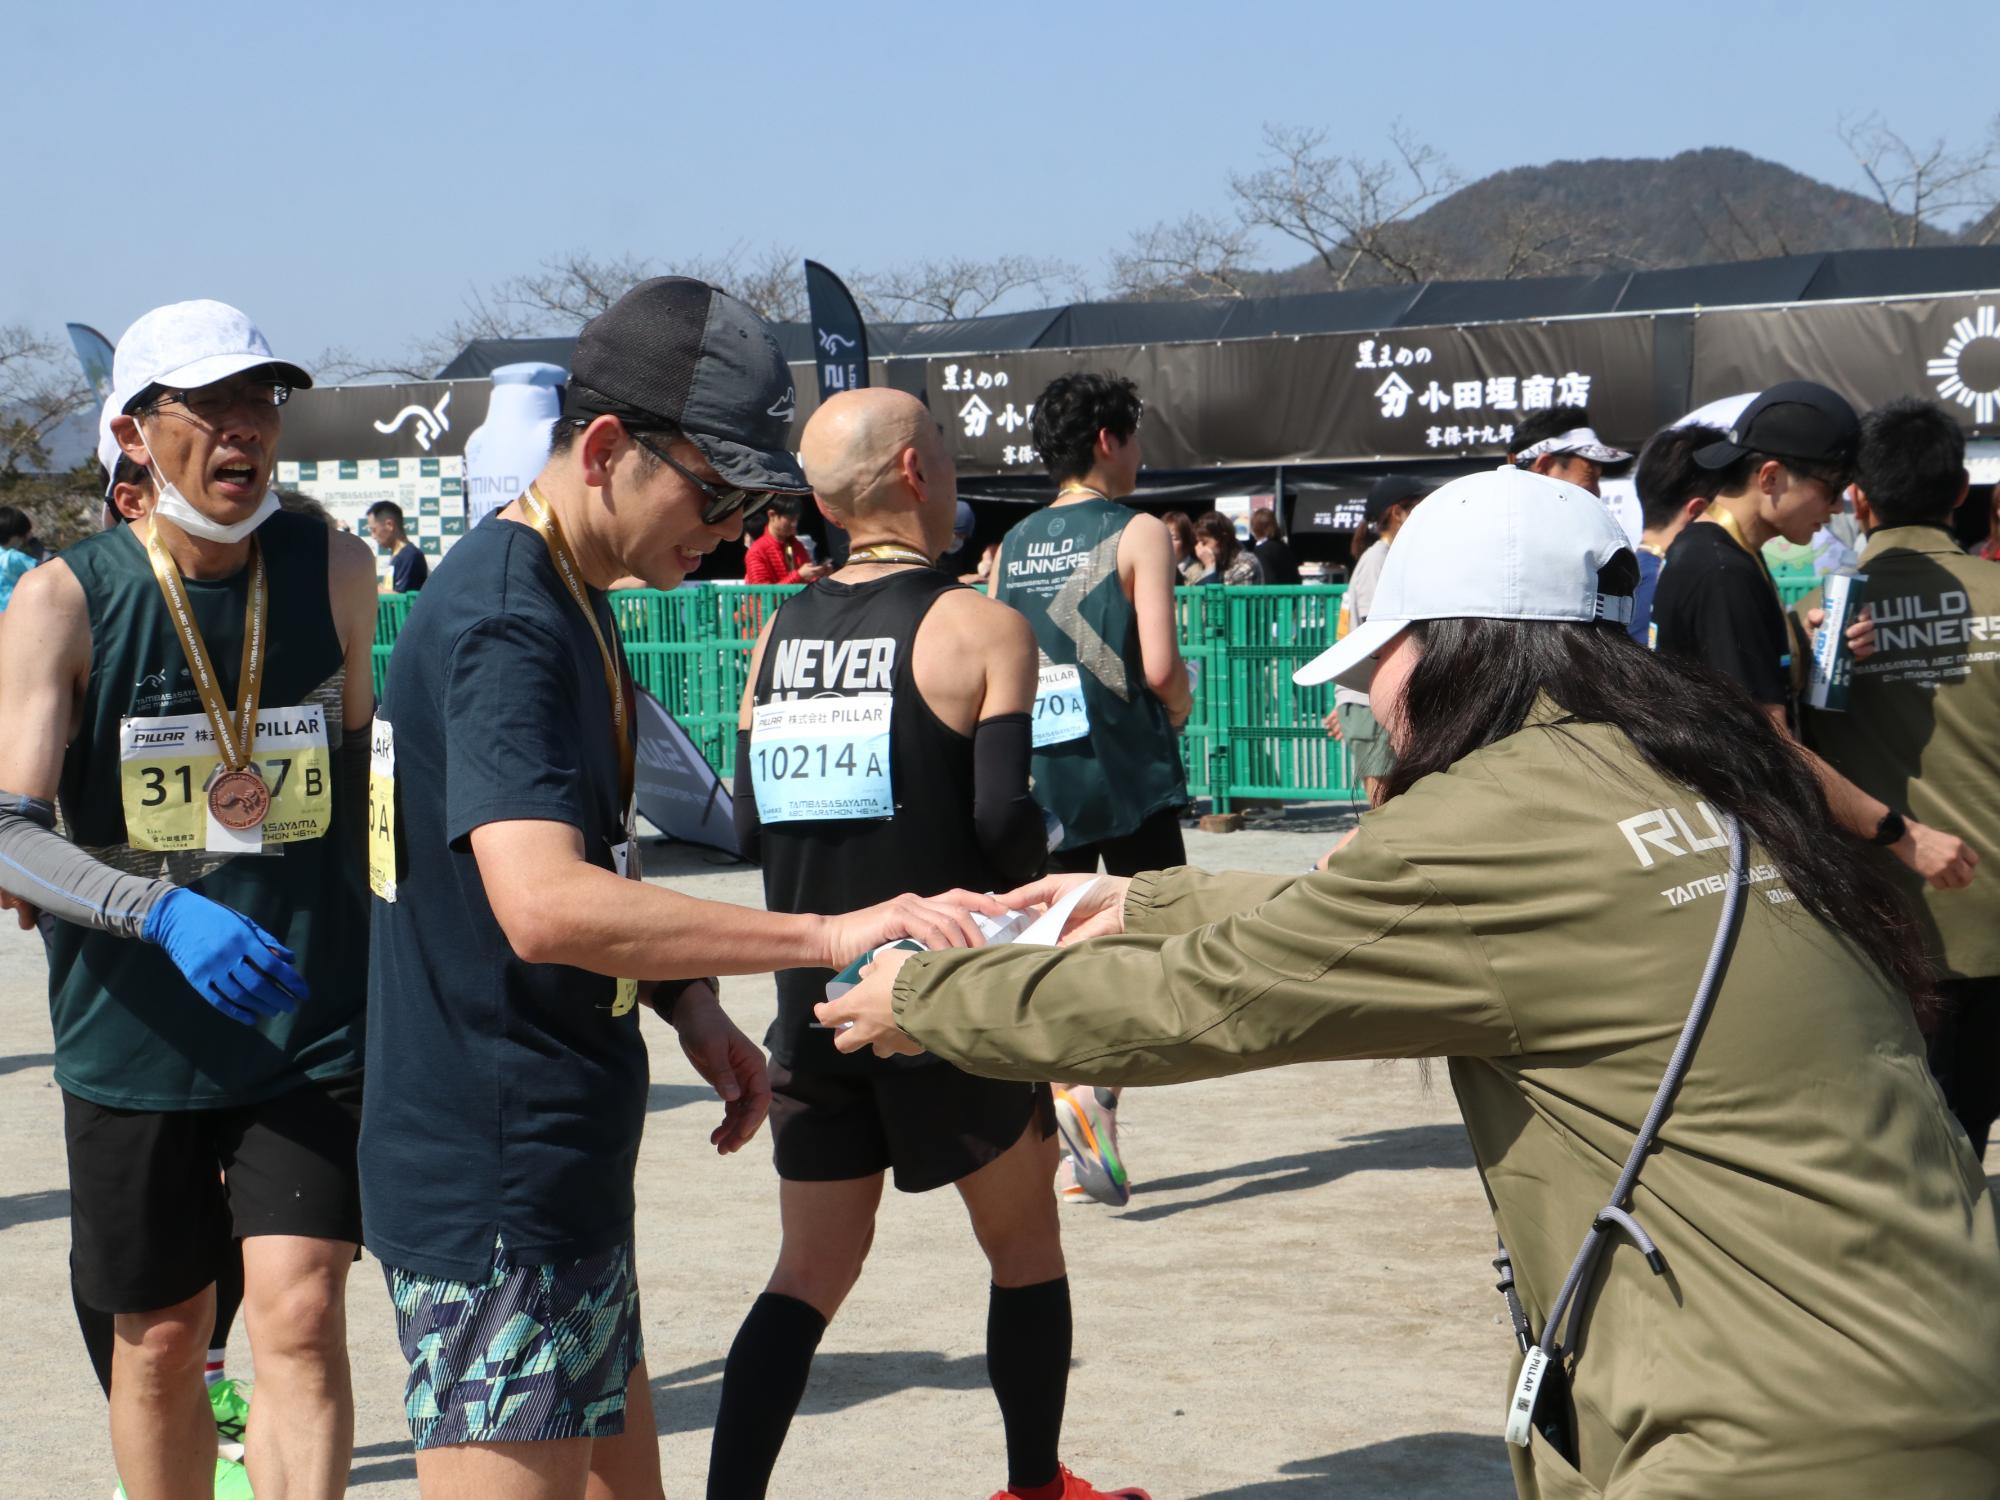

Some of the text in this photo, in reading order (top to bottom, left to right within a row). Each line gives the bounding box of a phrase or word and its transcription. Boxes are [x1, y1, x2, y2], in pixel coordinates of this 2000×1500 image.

[1027, 538, 1074, 557] WILD
[1007, 552, 1090, 577] RUNNERS
[1871, 591, 1968, 623] WILD
[184, 627, 204, 669] MARATHON
[773, 637, 896, 690] NEVER
[1038, 670, 1075, 685] PILLAR
[832, 709, 883, 723] PILLAR
[1032, 695, 1083, 720] 70 A
[133, 731, 185, 743] PILLAR
[255, 719, 319, 738] PILLAR
[758, 743, 883, 782] 10214 A
[141, 759, 291, 807] 317
[305, 768, 323, 797] B
[788, 798, 879, 809] TAMBASASAYAMA
[1522, 1358, 1541, 1393] PILLAR
